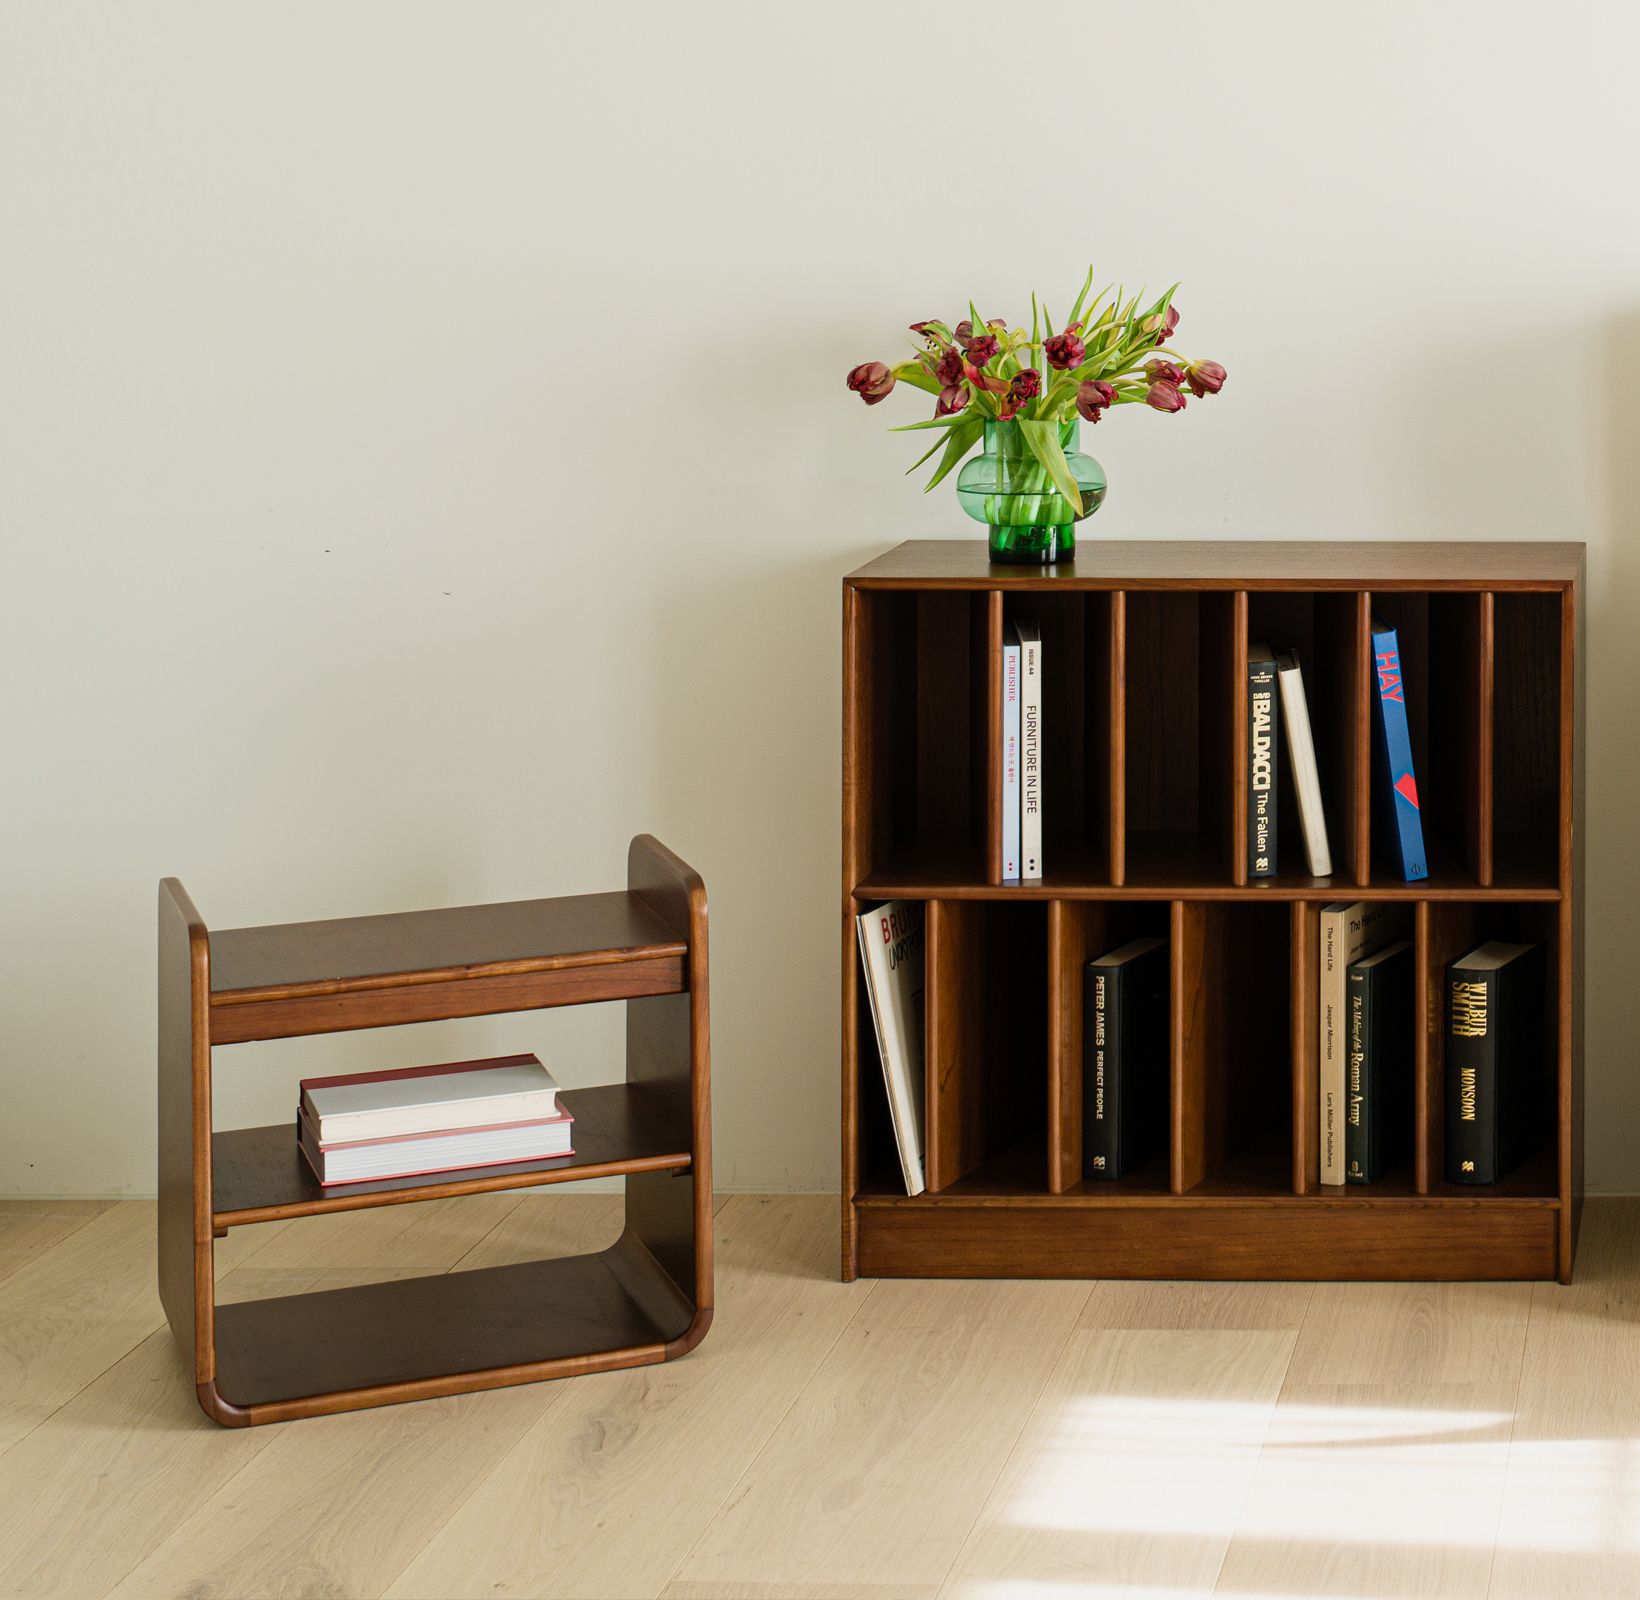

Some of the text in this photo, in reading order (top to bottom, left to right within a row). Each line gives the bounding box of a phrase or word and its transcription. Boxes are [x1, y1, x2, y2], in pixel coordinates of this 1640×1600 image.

[1008, 655, 1016, 702] PUBLISHER
[1028, 667, 1034, 675] 44
[1376, 651, 1404, 703] HAY
[1026, 705, 1037, 814] FURNITURE IN LIFE
[1253, 700, 1271, 790] BALDACCI
[1257, 793, 1268, 852] The Fallen
[1326, 927, 1334, 972] The Hard Life
[1095, 976, 1104, 1046] PETER JAMES
[1353, 996, 1362, 1009] The
[1452, 981, 1470, 1036] SMITH
[1469, 981, 1487, 1037] WILBUR
[1326, 1004, 1334, 1060] Jasper Morrison
[1096, 1051, 1104, 1119] PERFECT PEOPLE
[1350, 1052, 1364, 1091] Roman
[1461, 1067, 1476, 1121] MONSOON
[1326, 1092, 1334, 1168] Lars Müller Publishers
[1349, 1093, 1364, 1126] Army
